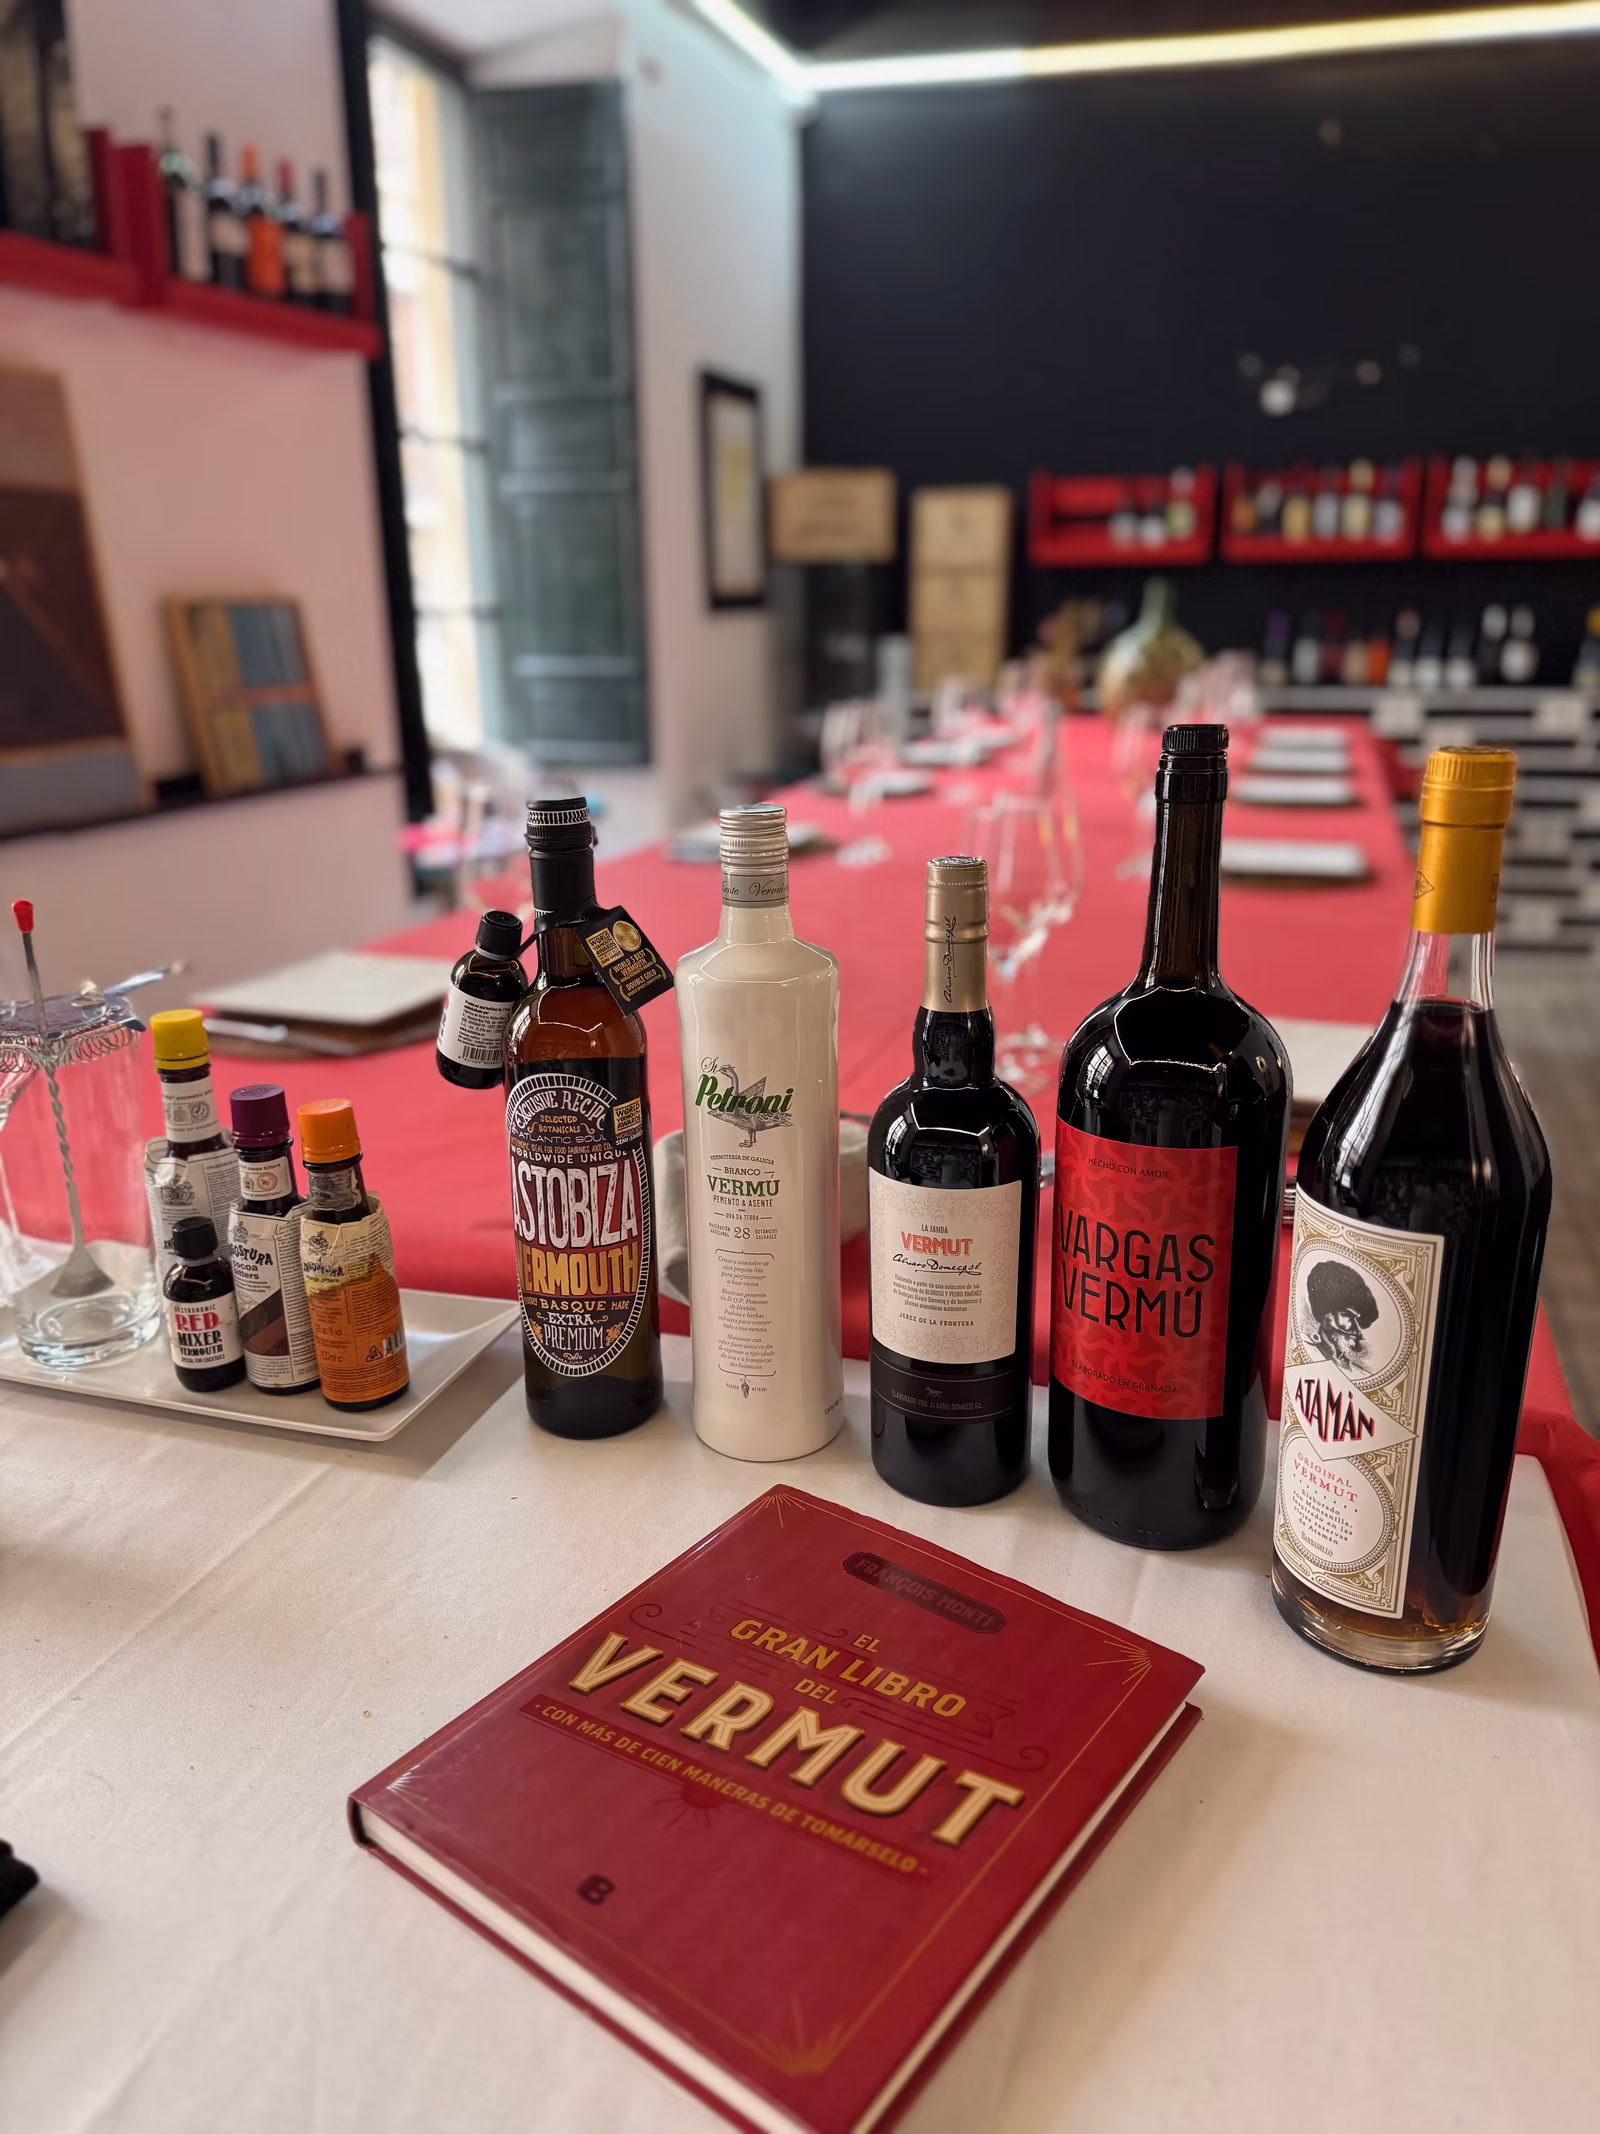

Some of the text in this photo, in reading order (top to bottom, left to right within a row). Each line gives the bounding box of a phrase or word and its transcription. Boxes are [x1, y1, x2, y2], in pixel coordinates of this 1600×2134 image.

[590, 932, 611, 946] WORLD
[596, 942, 617, 955] AWARDS
[626, 976, 643, 990] DOUBLE
[643, 969, 656, 980] GOLD
[695, 1074, 794, 1114] Petroni
[516, 1091, 558, 1129] EXCLUSIVE
[616, 1103, 640, 1116] WORLD
[541, 1115, 577, 1123] SELECTED
[618, 1116, 641, 1129] AWARDS
[539, 1124, 580, 1134] BOTANICALS
[519, 1132, 606, 1144] ATLANTIC SOUL
[511, 1144, 627, 1164] WORLDWIDE UNIQUE
[532, 1142, 543, 1152] IDEAL
[555, 1146, 566, 1154] FOOD
[568, 1145, 590, 1155] PAIRINGS
[592, 1143, 602, 1152] AND
[751, 1156, 774, 1165] GALICIA
[1088, 1157, 1169, 1179] HECHO CON AMOR
[724, 1167, 760, 1176] BRANCO
[707, 1174, 780, 1197] VERMÚ
[512, 1159, 638, 1249] ASTOBIZA
[714, 1195, 739, 1206] PEMENTO
[749, 1199, 773, 1207] ASENTE
[734, 1227, 750, 1239] 28
[930, 1225, 948, 1233] JANDA
[901, 1231, 973, 1256] VERMUT
[1059, 1202, 1215, 1284] VARGAS
[233, 1260, 258, 1271] cocoa
[893, 1282, 906, 1291] mejores
[964, 1289, 982, 1297] XIMÉNEZ
[895, 1274, 912, 1284] Elaborado
[917, 1280, 928, 1288] partir
[898, 1289, 913, 1299] Bodegas
[928, 1297, 946, 1305] Domecq
[905, 1300, 918, 1308] plantas
[1061, 1260, 1202, 1339] VERMÚ
[540, 1299, 630, 1313] BASQUE MADE
[176, 1312, 220, 1331] RED
[548, 1312, 593, 1325] EXTRA
[899, 1313, 916, 1321] JEREZ
[178, 1330, 222, 1347] MIXER
[544, 1324, 604, 1350] PREMIUM
[180, 1344, 223, 1356] VERMOUTH
[204, 1354, 225, 1363] COCKTAILS
[1071, 1360, 1178, 1394] ELABORADO EN GRANADA
[892, 1390, 917, 1405] ELABORADO
[918, 1399, 928, 1407] POR
[1298, 1452, 1352, 1488] ORIGINAL
[1294, 1459, 1358, 1502] VERMUT
[1293, 1491, 1304, 1502] con
[1302, 1489, 1340, 1515] Elaborado
[1293, 1496, 1353, 1536] Inspirado en las
[1294, 1507, 1348, 1542] viejas reservas
[1299, 1517, 1339, 1545] de Atamán
[855, 1558, 994, 1628] FRANÇOIS MONTI
[853, 1634, 880, 1653] EL
[730, 1619, 966, 1717] GRAN LIBRO
[793, 1678, 838, 1704] DEL
[568, 1632, 1025, 1848] VERMUT
[541, 1705, 919, 1874] CON MÁS DE CIEN MANERAS DE TOMÁRSELO
